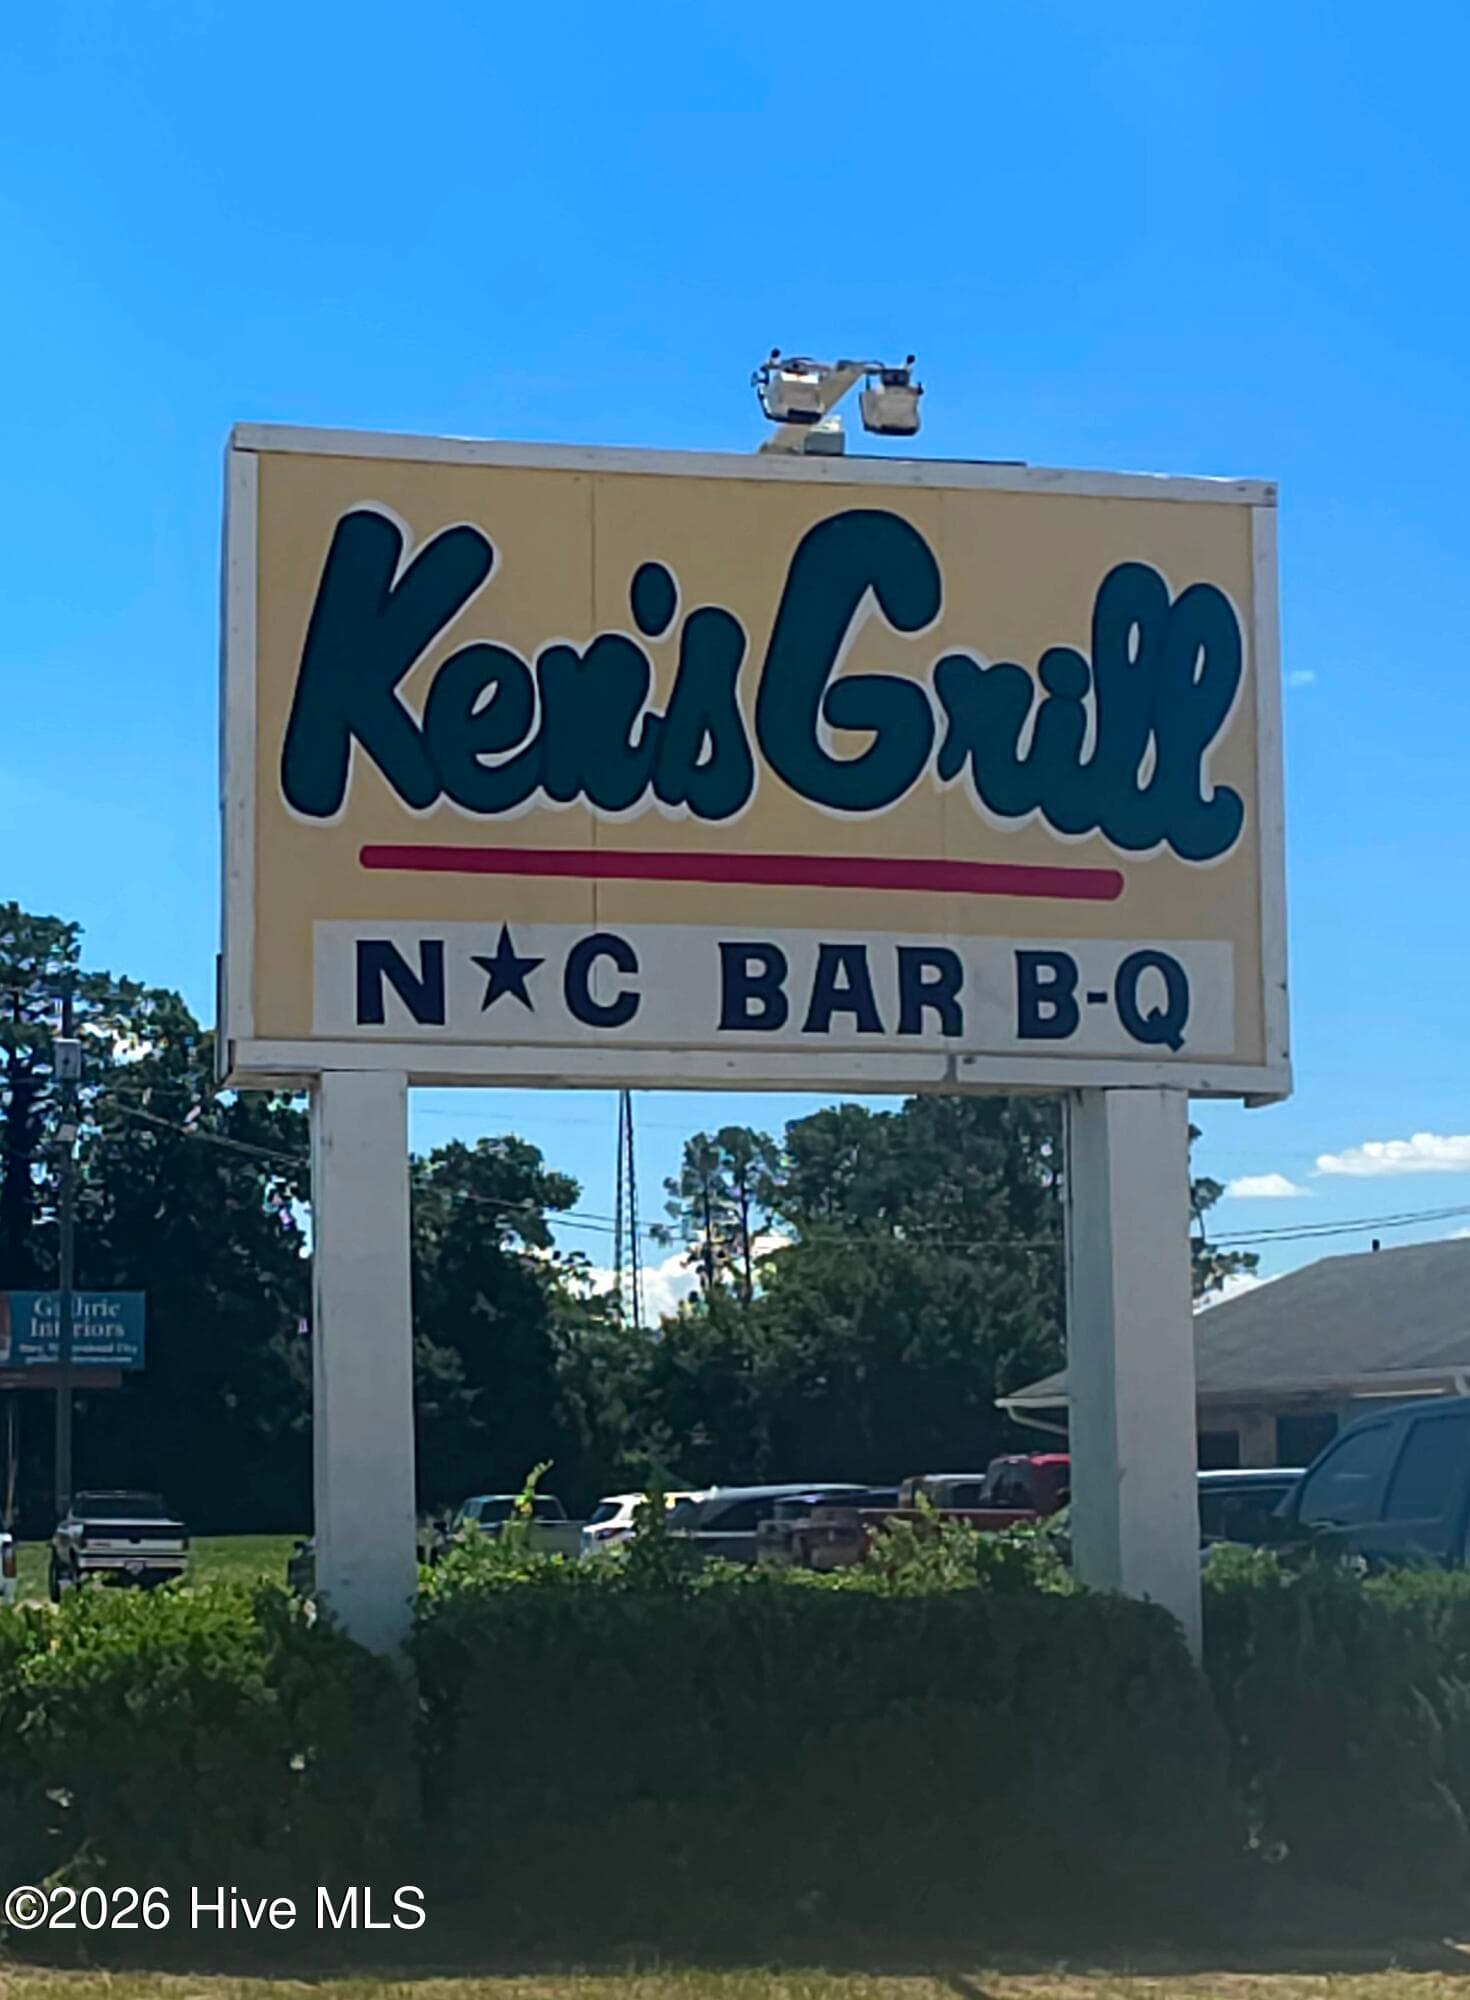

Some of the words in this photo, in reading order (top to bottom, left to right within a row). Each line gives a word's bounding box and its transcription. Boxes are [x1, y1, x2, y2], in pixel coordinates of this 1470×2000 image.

[280, 508, 756, 821] Ken's
[754, 507, 1245, 861] Grill
[356, 938, 446, 1027] N
[562, 931, 642, 1030] C
[716, 941, 965, 1038] BAR
[1015, 949, 1191, 1054] B-Q
[30, 1317, 126, 1338] Intriors
